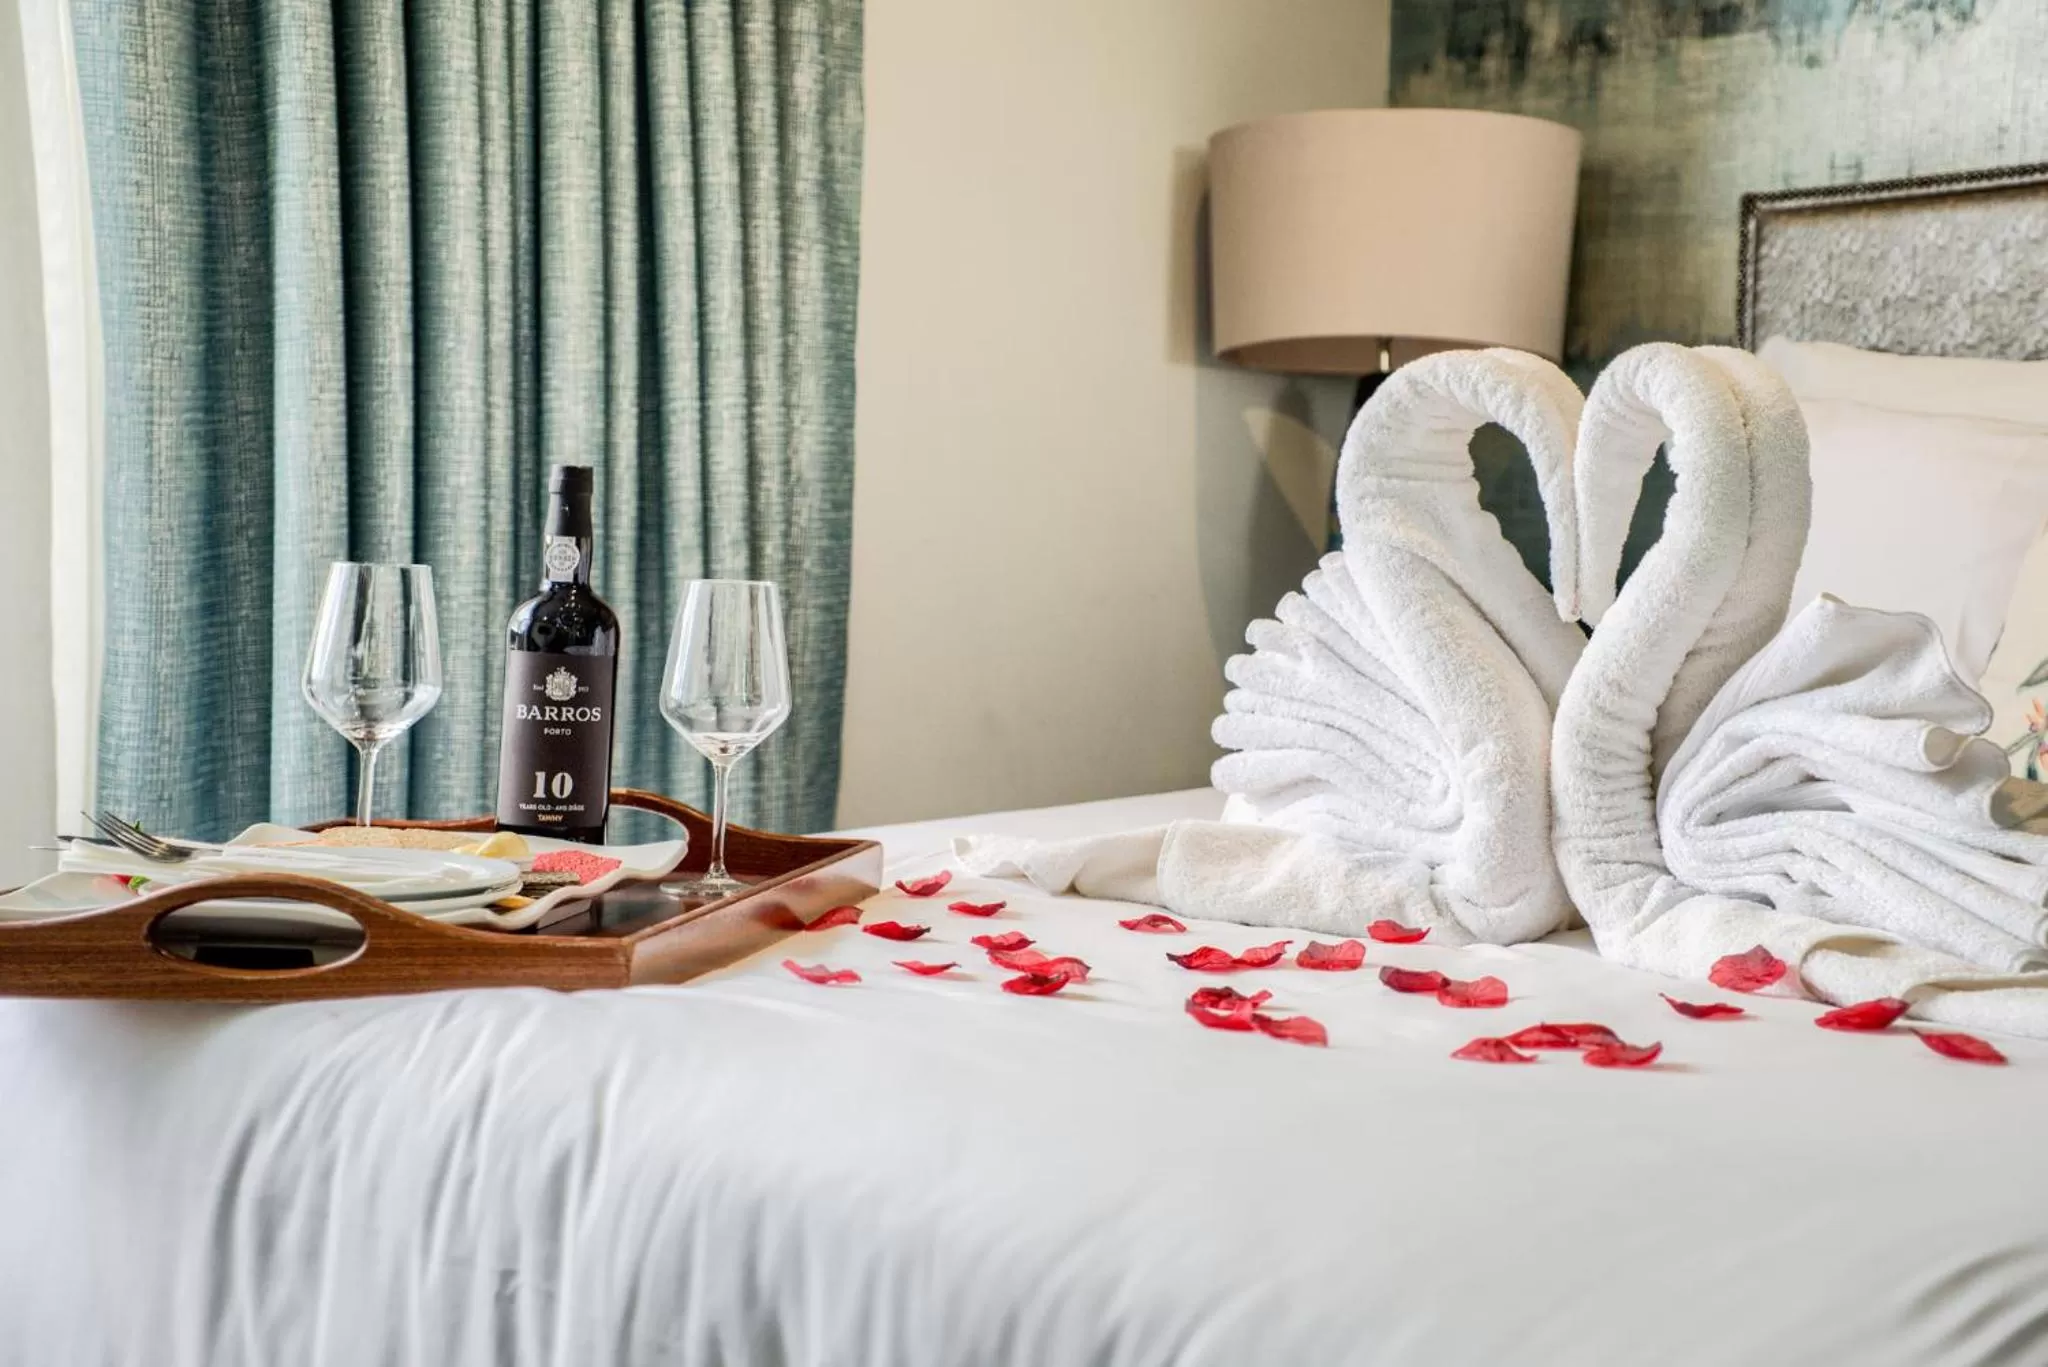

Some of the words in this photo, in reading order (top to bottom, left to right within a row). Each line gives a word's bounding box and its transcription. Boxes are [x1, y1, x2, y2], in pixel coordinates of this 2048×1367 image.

[516, 704, 602, 722] BARROS
[543, 727, 572, 736] PORTO
[533, 771, 574, 799] 10
